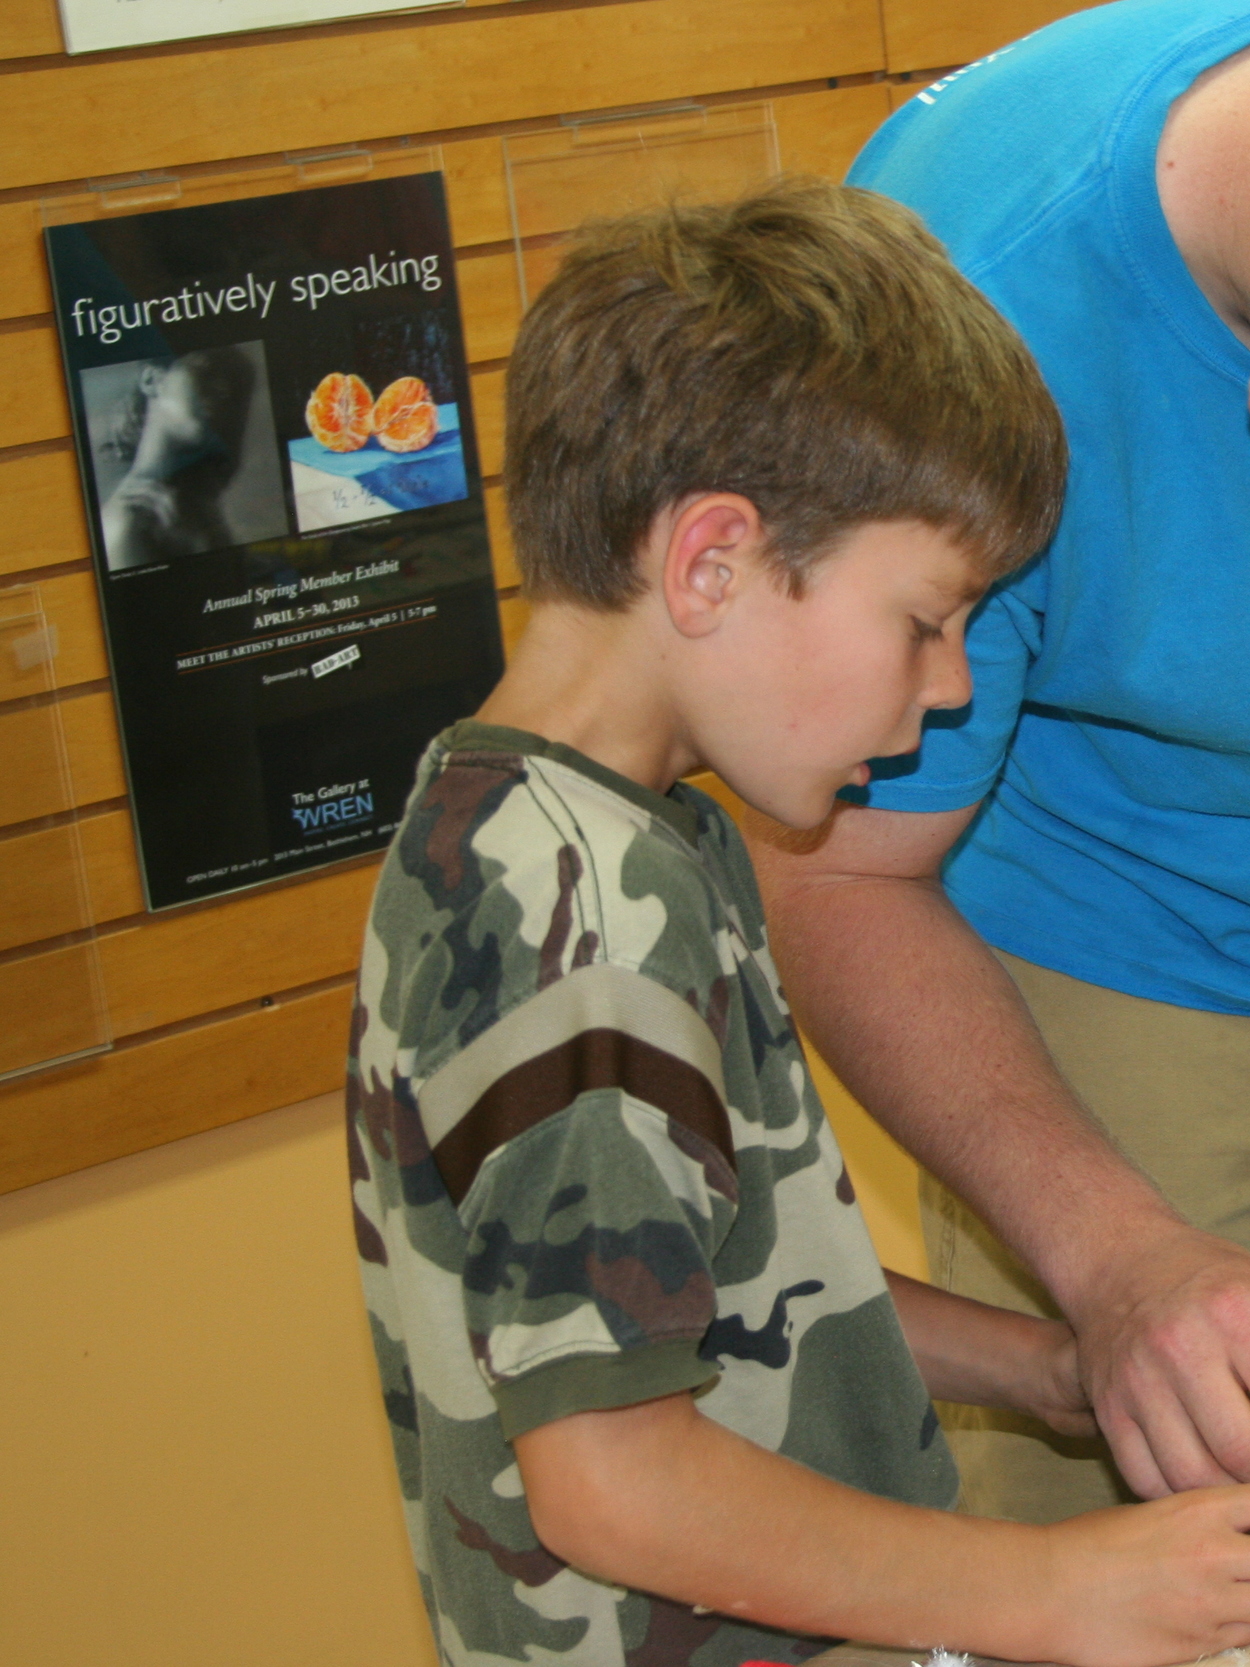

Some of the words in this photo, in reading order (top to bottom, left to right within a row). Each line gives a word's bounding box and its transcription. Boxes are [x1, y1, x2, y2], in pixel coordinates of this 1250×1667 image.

[71, 272, 276, 344] figuratively
[290, 250, 442, 310] speaking
[202, 588, 254, 614] Annual
[254, 583, 299, 606] Spring
[300, 570, 353, 592] Member
[355, 560, 401, 580] Exhibit
[253, 609, 297, 629] APRIL
[331, 595, 360, 612] 2013
[176, 654, 206, 670] MEET
[207, 649, 230, 663] THE
[292, 792, 316, 805] The
[317, 782, 357, 800] Gallery
[358, 778, 371, 790] at
[293, 792, 374, 830] WREN
